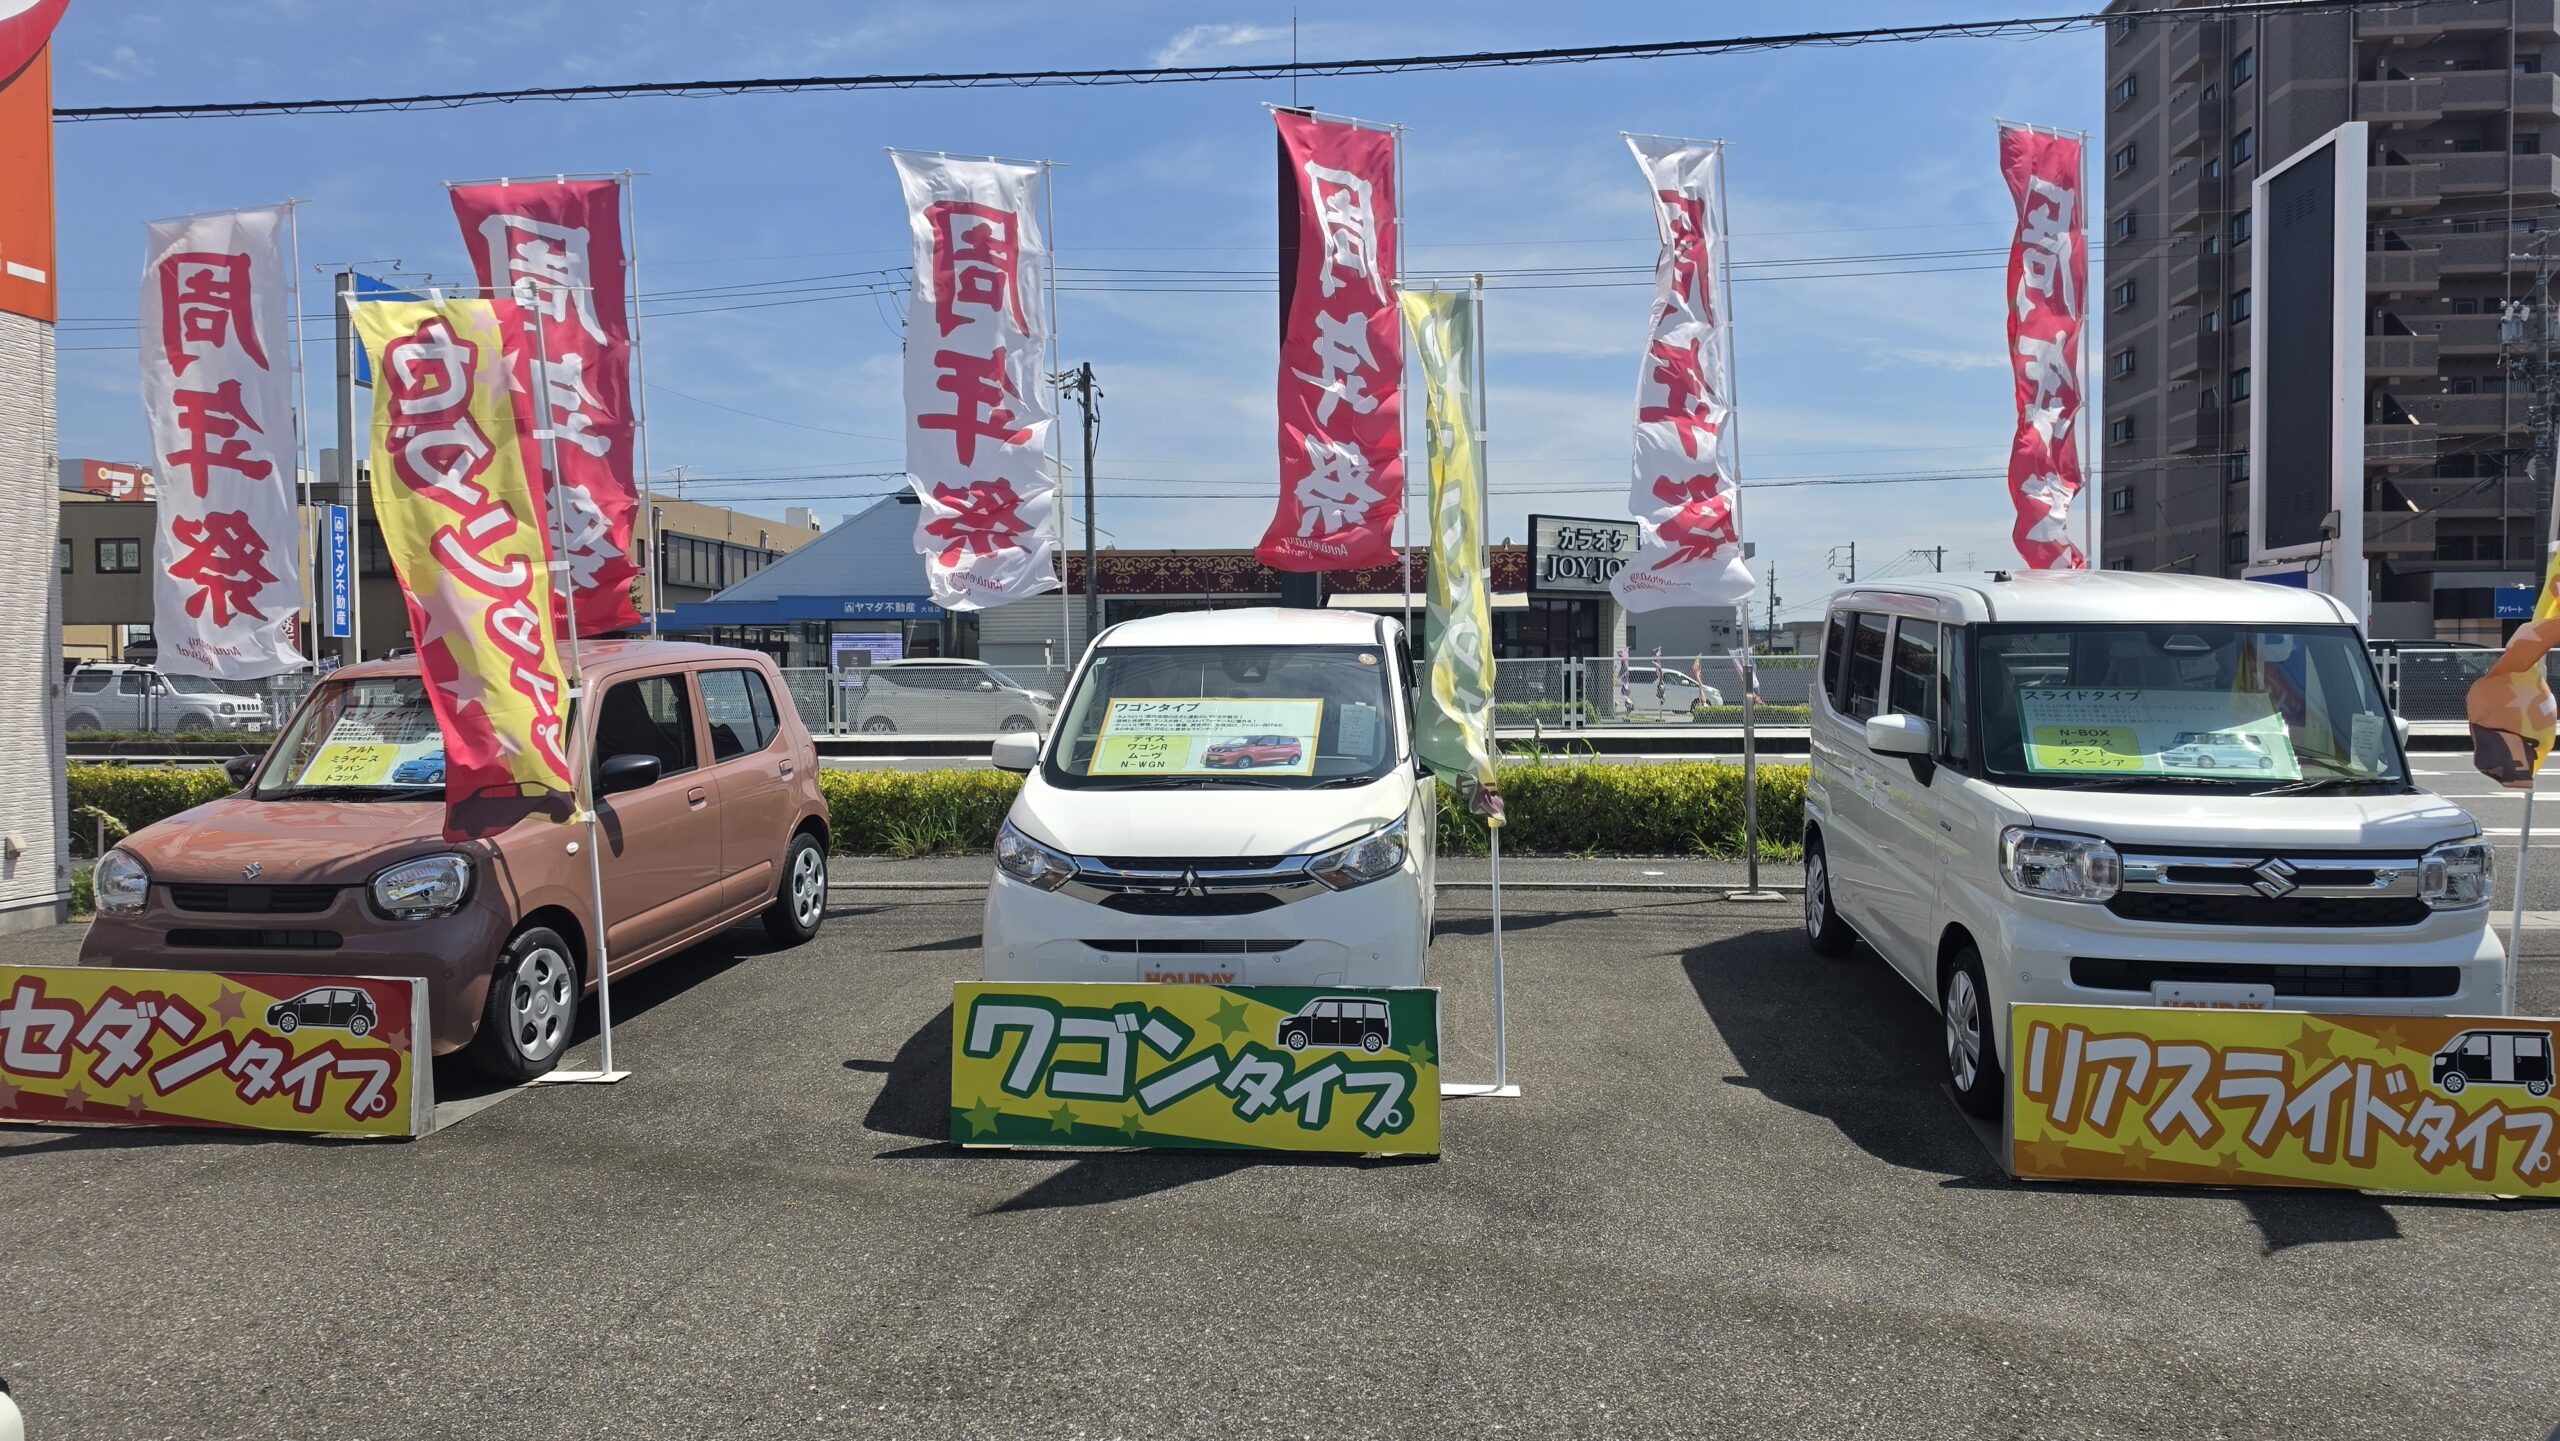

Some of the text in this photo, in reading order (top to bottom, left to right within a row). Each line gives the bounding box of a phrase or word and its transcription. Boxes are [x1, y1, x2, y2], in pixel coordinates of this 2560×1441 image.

[1558, 527, 1628, 552] カラオケ
[1594, 556, 1629, 583] JO
[334, 533, 347, 626] ヤマダ不動産
[854, 601, 916, 613] ヤマダ不動産
[2497, 605, 2524, 613] アパート
[2023, 690, 2142, 701] スライドタイプ
[1114, 702, 1201, 713] ワゴンタイプ
[2060, 729, 2110, 737] N-BOX
[346, 746, 375, 754] アルト
[1127, 743, 1168, 751] ワゴンR
[2070, 748, 2107, 757] タント
[331, 755, 379, 763] ミライース
[1120, 760, 1165, 768] N-WGN
[2057, 757, 2125, 767] スペーシア
[325, 774, 359, 782] トコット
[0, 982, 392, 1114] セダンタイプ
[968, 1003, 1405, 1134] ワゴンタイプ
[2026, 1025, 2556, 1179] リアスライドタイプ
